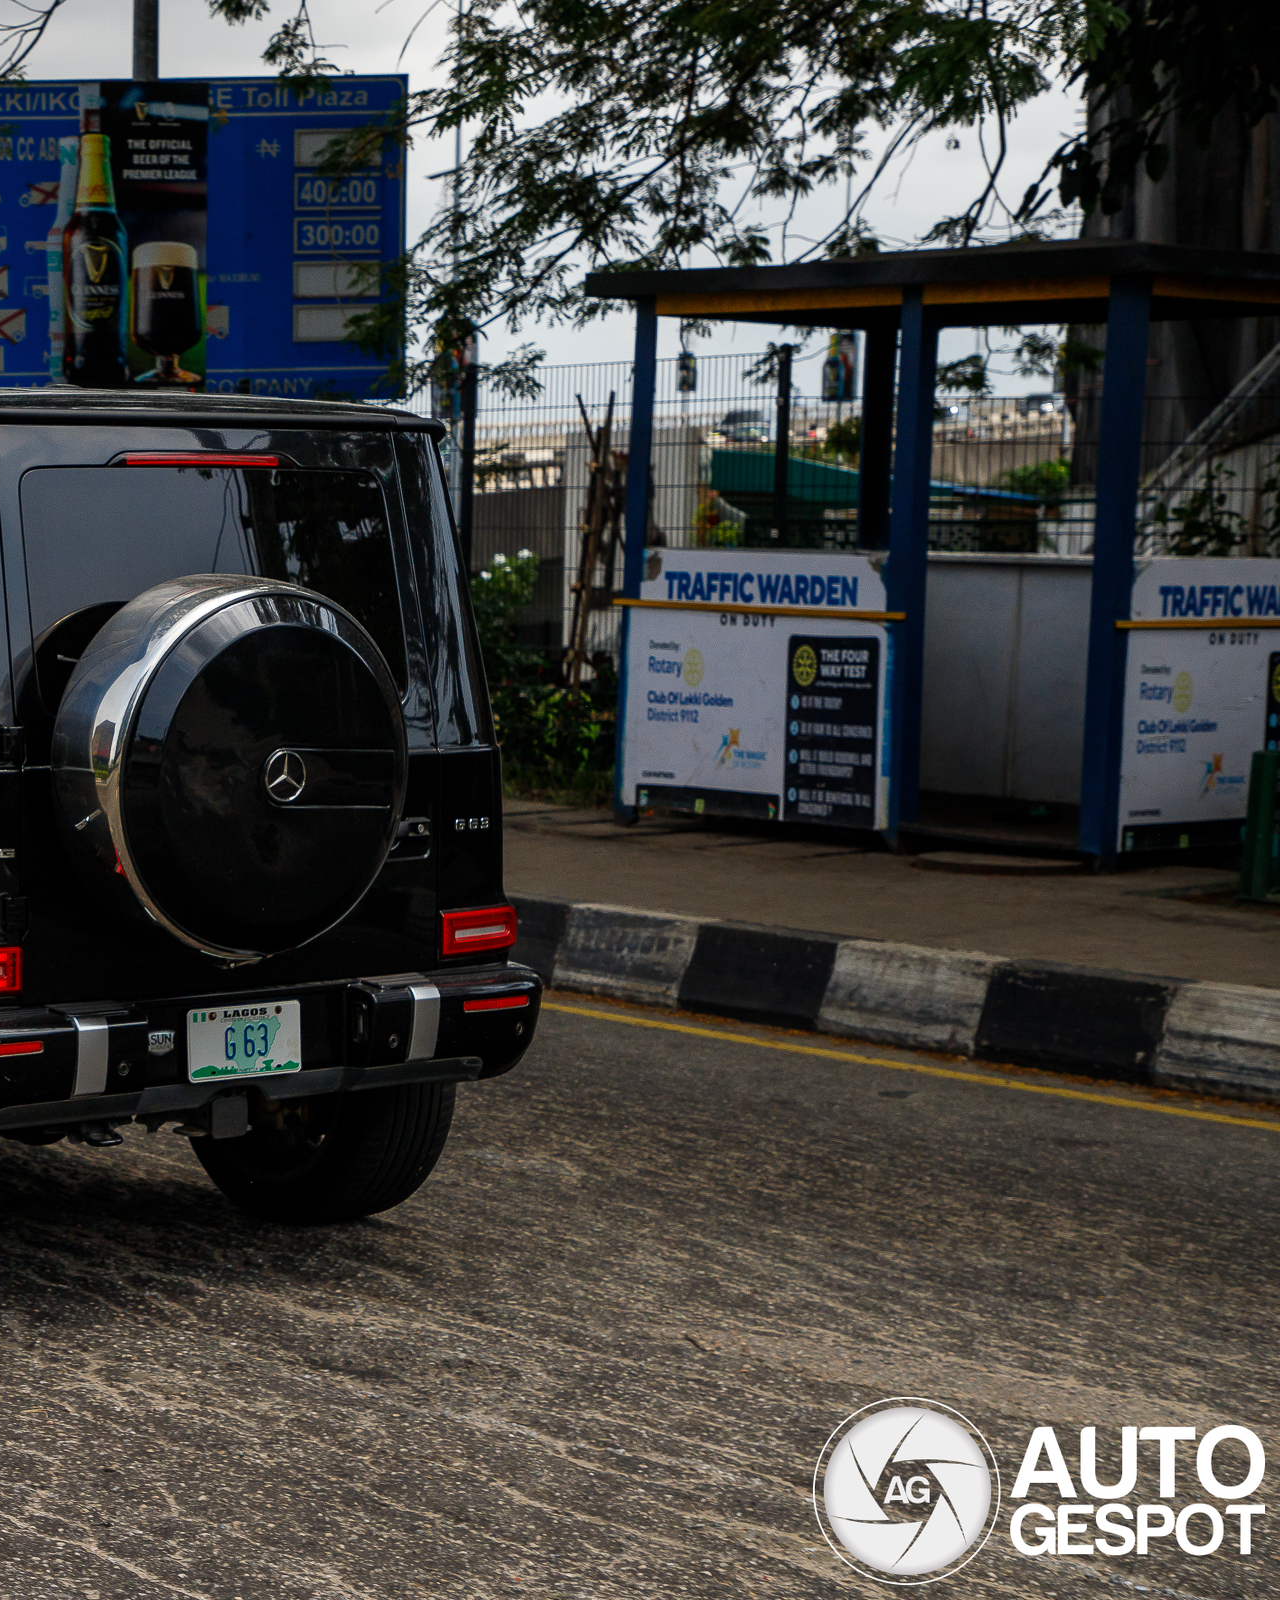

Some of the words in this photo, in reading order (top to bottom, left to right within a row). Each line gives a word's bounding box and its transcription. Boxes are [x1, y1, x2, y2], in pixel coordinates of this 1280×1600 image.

[242, 87, 288, 108] Toll
[298, 87, 368, 107] Plaza
[17, 136, 35, 161] CC
[127, 139, 147, 150] THE
[302, 224, 379, 246] 300:00
[207, 378, 313, 394] COPANY
[664, 571, 755, 602] TRAFFIC
[757, 573, 859, 607] WARDEN
[1159, 585, 1245, 617] TRAFFIC
[1246, 585, 1280, 617] WA
[720, 614, 737, 627] ON
[742, 614, 777, 628] DUTY
[1209, 632, 1226, 646] ON
[1230, 632, 1259, 646] DUTY
[820, 649, 841, 663] THE
[841, 649, 870, 664] FOUR
[648, 655, 682, 678] Rotary
[820, 664, 842, 678] WAY
[843, 665, 868, 679] TEST
[647, 690, 666, 704] Club
[1139, 681, 1173, 704] Rotary
[647, 707, 679, 723] District
[223, 1007, 268, 1019] LAGOS
[150, 1033, 172, 1046] SUN
